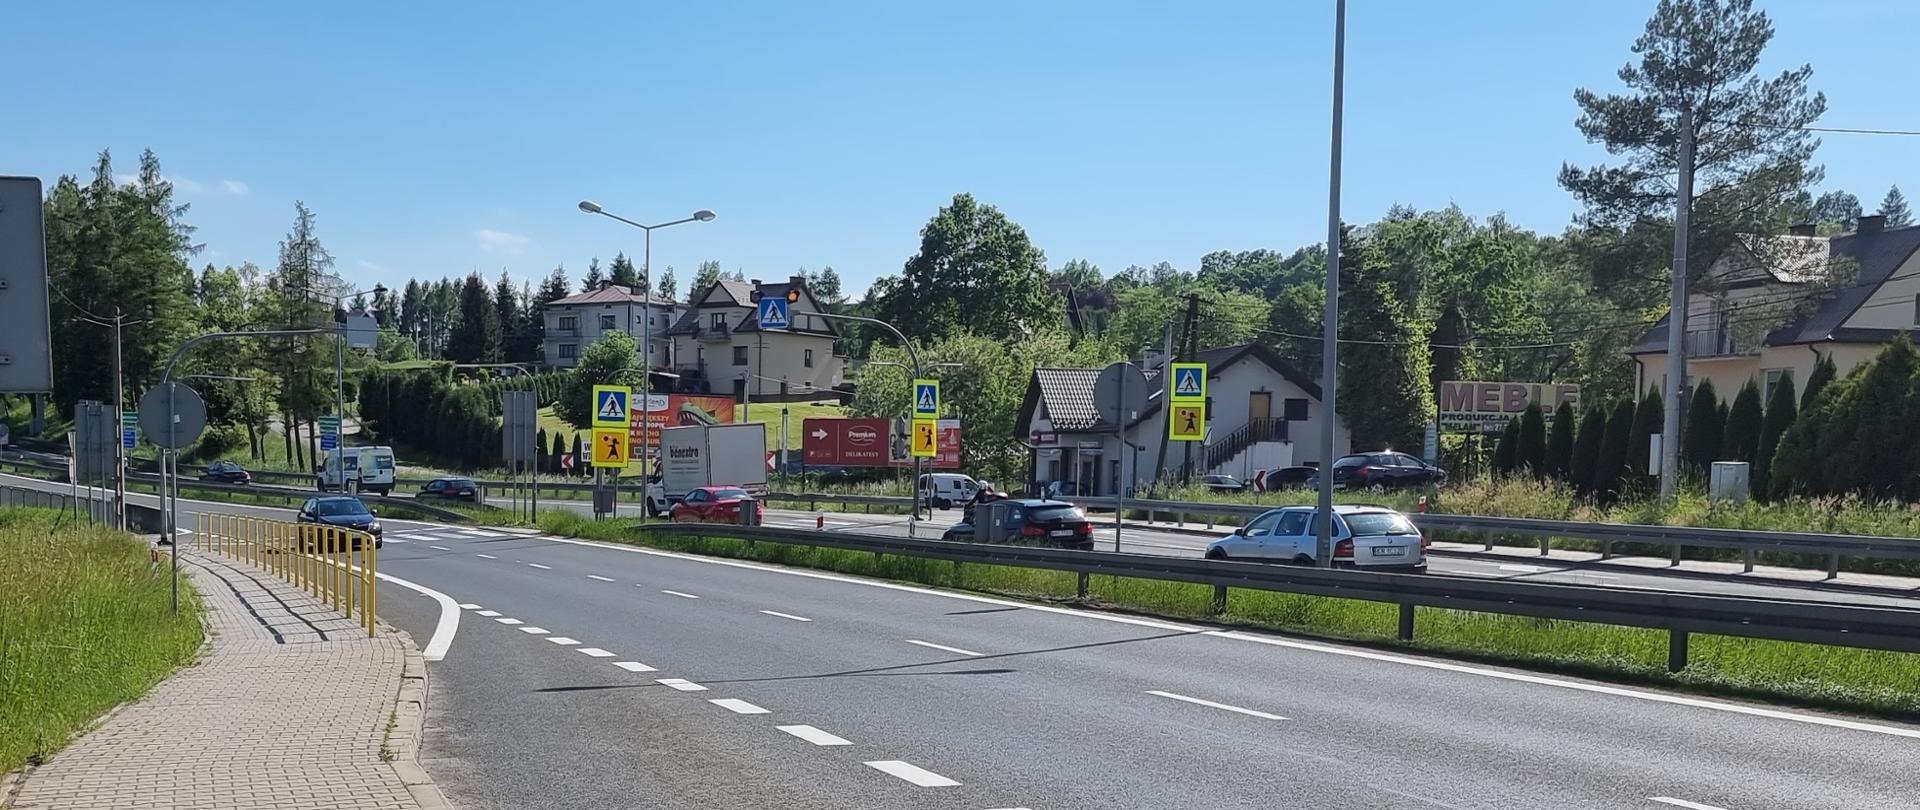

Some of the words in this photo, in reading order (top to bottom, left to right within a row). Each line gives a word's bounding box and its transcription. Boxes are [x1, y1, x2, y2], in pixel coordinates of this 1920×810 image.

[1441, 383, 1577, 413] MEBLE
[1441, 413, 1510, 422] PRODUKCJA
[848, 431, 877, 439] Premium
